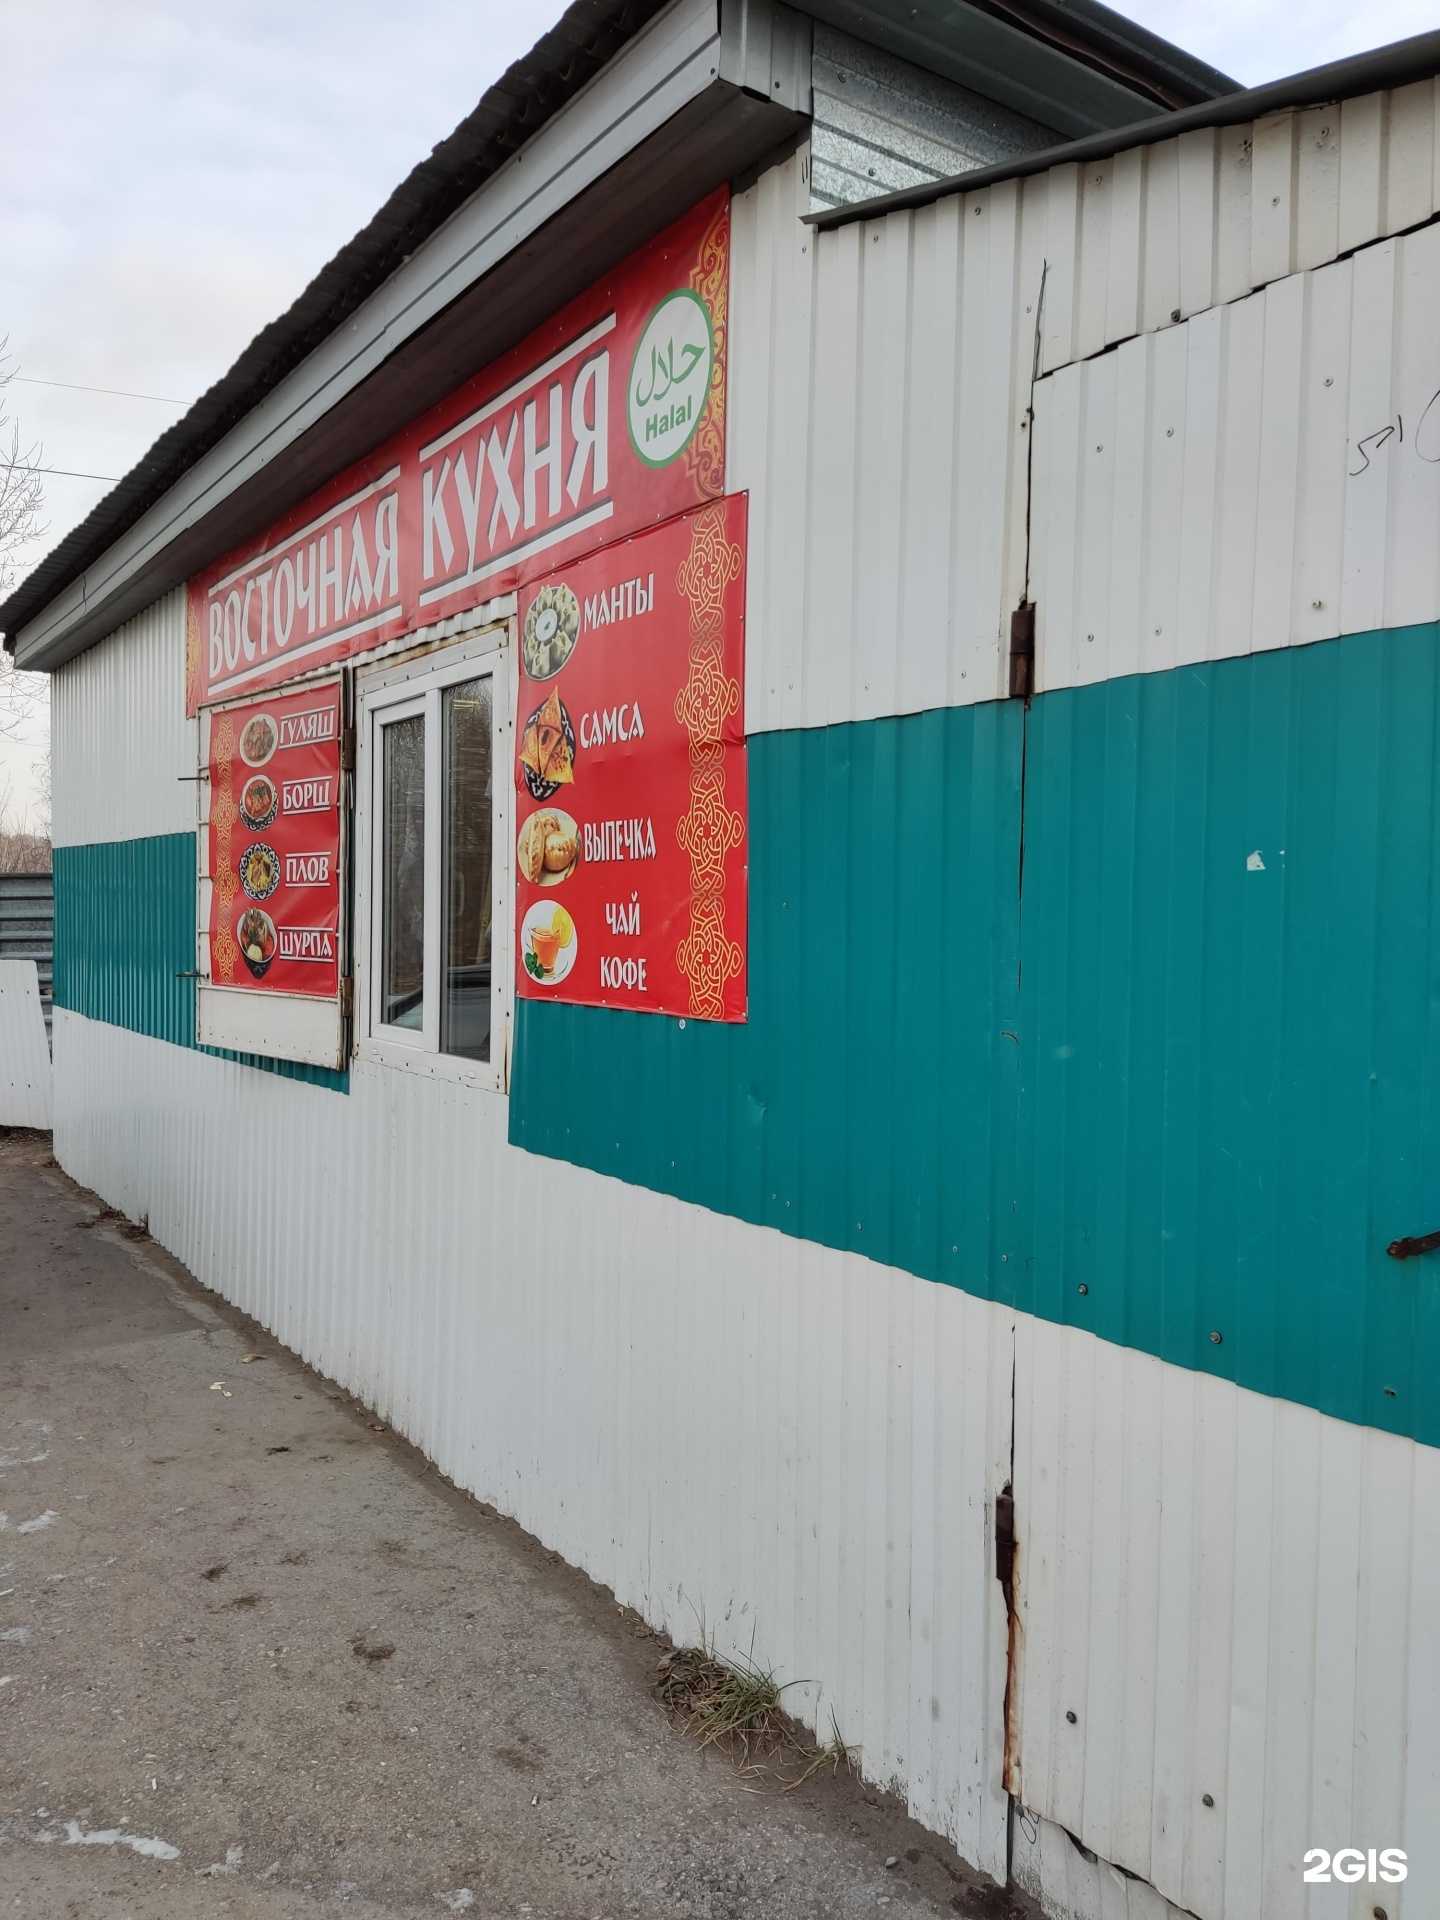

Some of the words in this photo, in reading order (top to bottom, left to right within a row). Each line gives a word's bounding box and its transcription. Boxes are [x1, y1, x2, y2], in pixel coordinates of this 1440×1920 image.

[635, 335, 706, 407] حلال
[645, 395, 693, 443] Halal
[208, 492, 399, 679] ВОСТОЧНАЯ
[421, 348, 610, 581] КУХНЯ
[583, 573, 655, 633] МАНТЫ
[279, 711, 334, 745] ГУЛЯШ
[579, 701, 645, 750] САМСА
[583, 816, 657, 863] ВЫПЕЧКА
[286, 856, 329, 882] ПЛОВ
[605, 891, 641, 937] ЧАЙ
[279, 932, 333, 957] ШУРПА
[600, 956, 648, 992] КОФЕ
